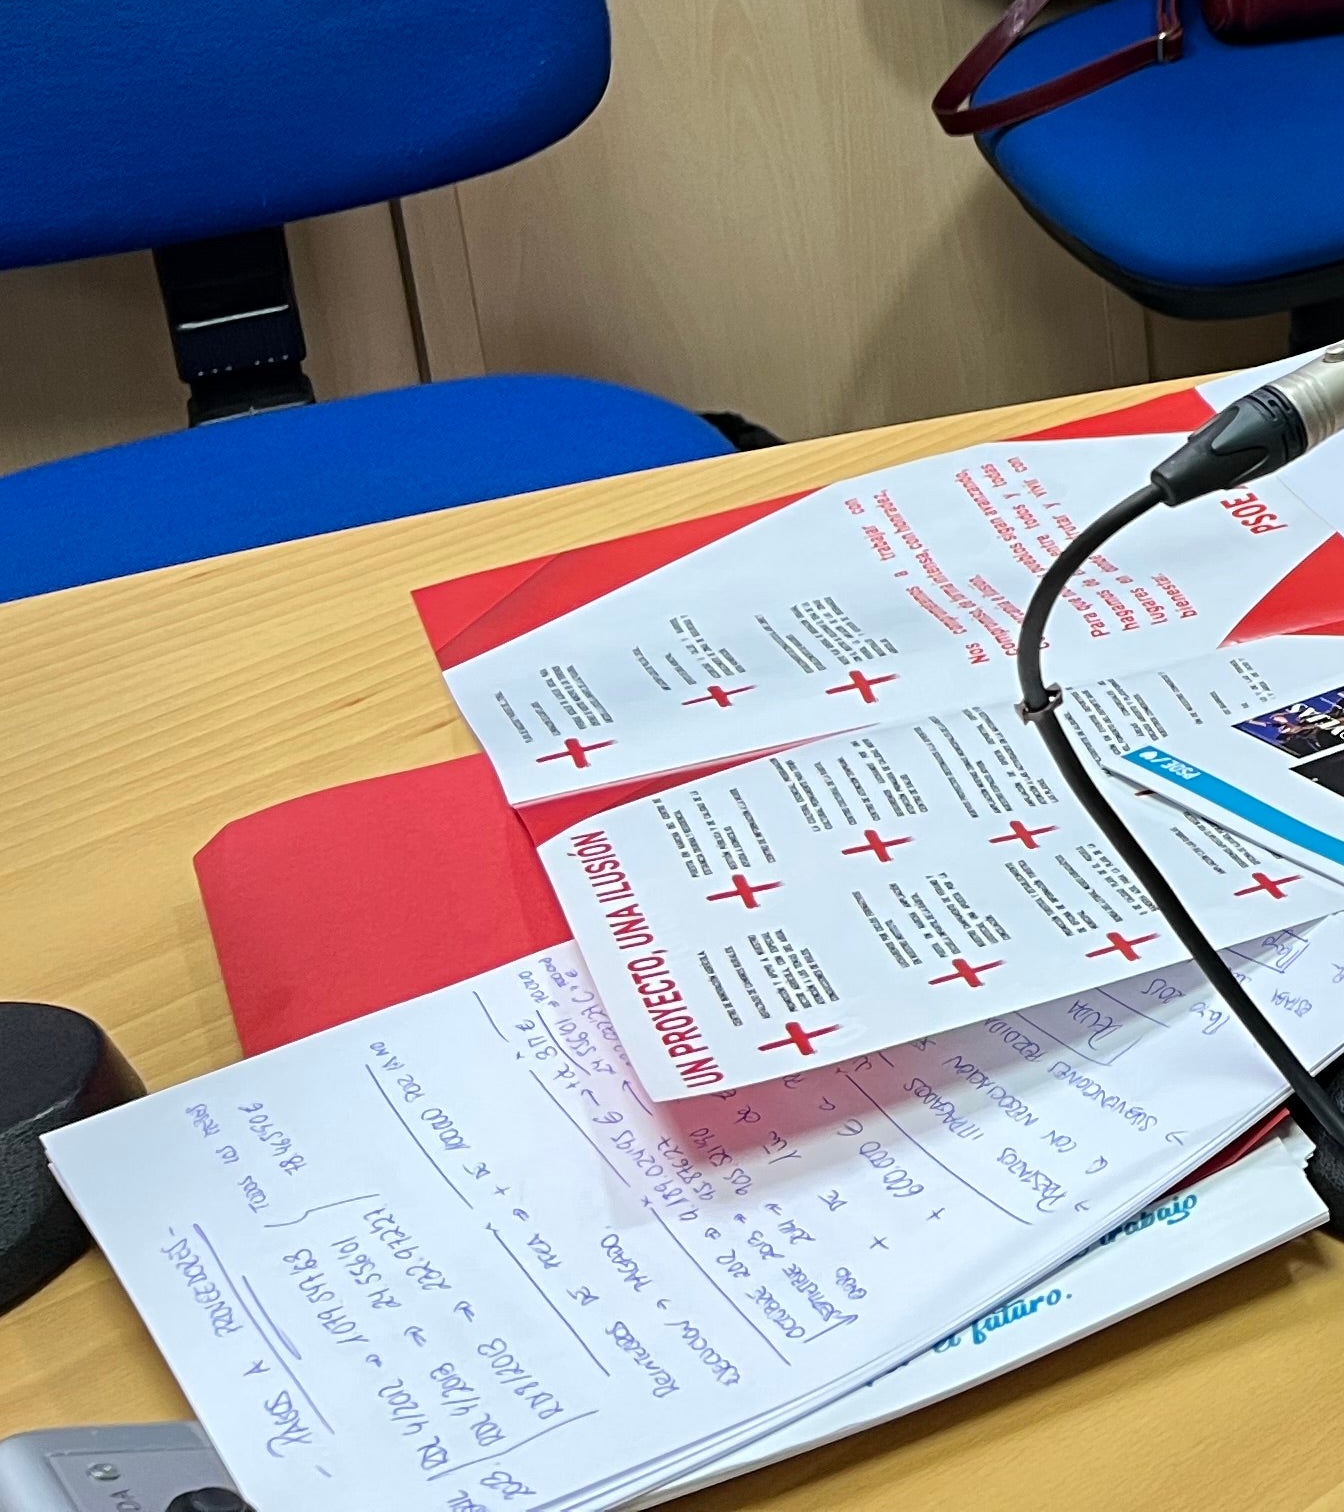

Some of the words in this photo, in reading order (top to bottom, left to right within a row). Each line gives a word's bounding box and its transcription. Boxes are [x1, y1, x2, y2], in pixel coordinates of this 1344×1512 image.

[981, 464, 1007, 487] todas
[1008, 457, 1027, 472] con
[955, 469, 997, 516] avanzando,
[1023, 479, 1047, 498] vivir
[845, 498, 864, 515] con
[874, 490, 910, 534] honradez,
[1013, 504, 1040, 529] todos
[1219, 489, 1288, 534] PSOE
[902, 532, 922, 550] con
[990, 517, 1017, 541] sigan
[862, 526, 896, 561] trabajar
[916, 549, 948, 585] intensa,
[1007, 543, 1046, 573] pueblos
[940, 583, 967, 603] forma
[1082, 579, 1100, 587] de
[1115, 576, 1133, 584] en
[958, 600, 976, 608] de
[1068, 597, 1093, 611] que
[1130, 588, 1168, 625] lugares
[1151, 573, 1197, 618] bienestar.
[1096, 590, 1139, 631] hagamos
[1083, 613, 1110, 637] Para
[966, 643, 990, 664] Nos
[567, 831, 634, 903] ILUSIÓN
[606, 904, 653, 949] UNA
[628, 950, 708, 1057] PROYECTO,
[982, 1012, 1046, 1064] PERDIDA
[676, 1057, 723, 1088] UN
[970, 1287, 1075, 1346] futuro.
[243, 1360, 270, 1376] A
